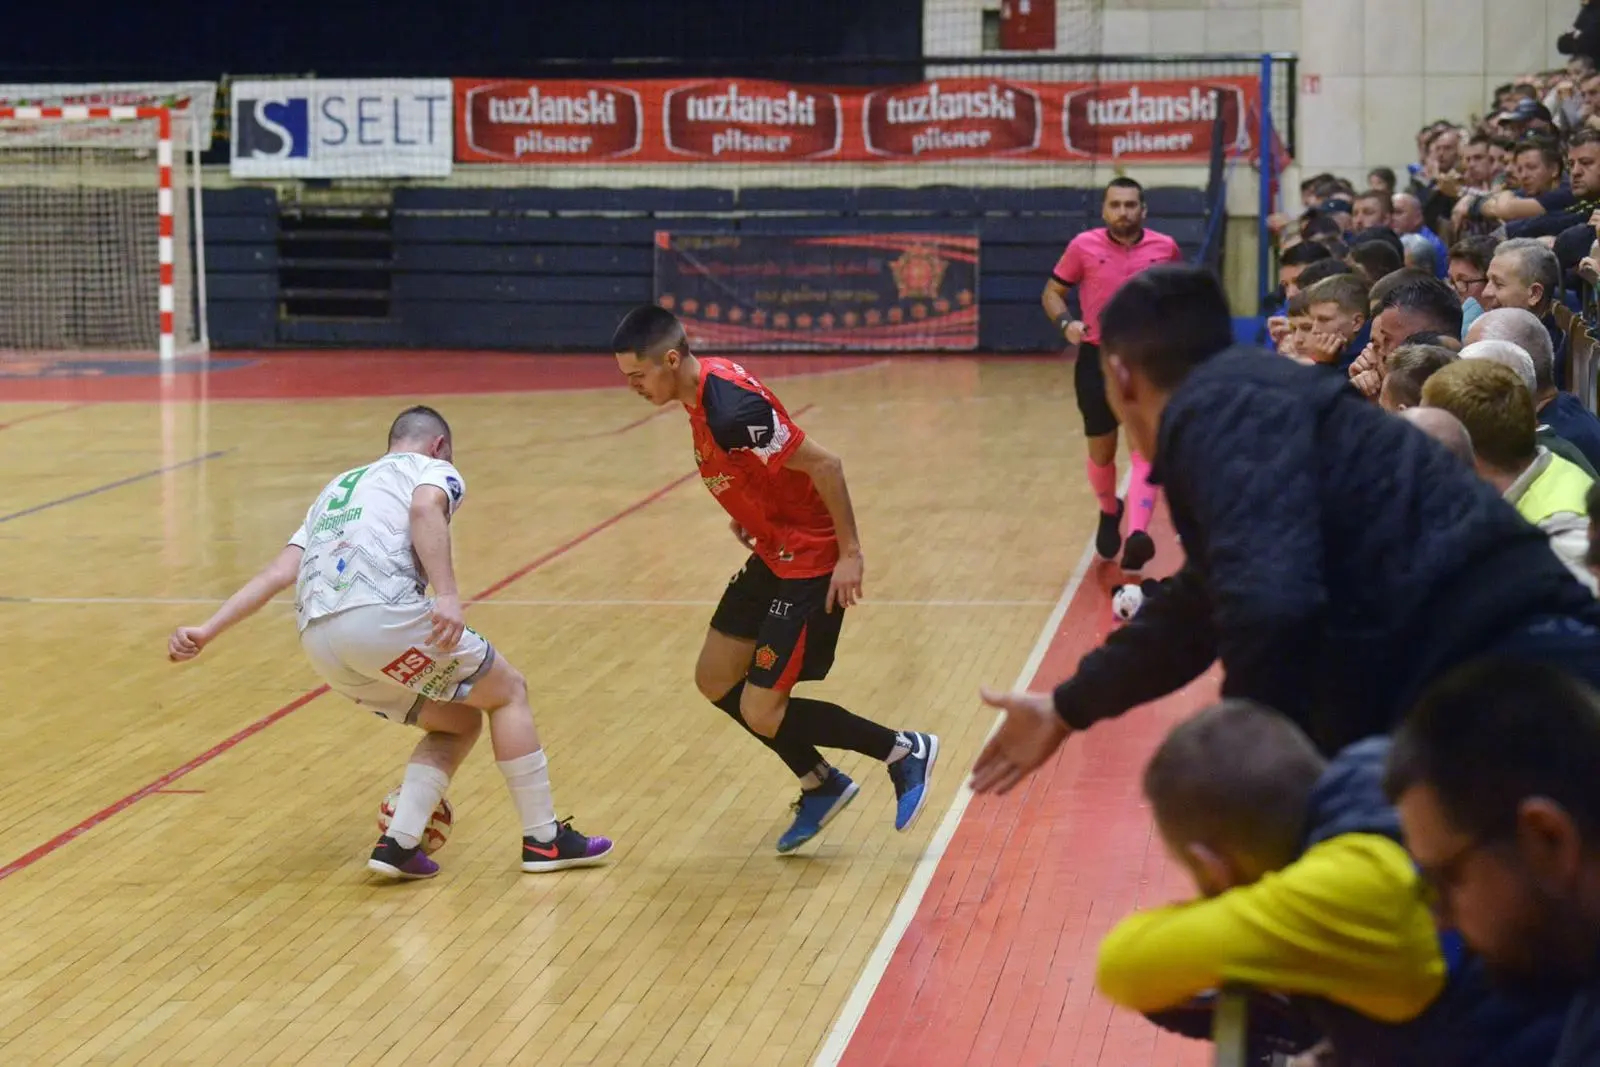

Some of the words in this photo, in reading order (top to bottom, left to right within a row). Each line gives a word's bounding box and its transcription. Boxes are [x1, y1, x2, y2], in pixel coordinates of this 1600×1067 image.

[321, 95, 446, 146] SELT
[489, 86, 616, 124] tuzlanski
[686, 84, 816, 125] tuzlanski
[886, 83, 1015, 124] tuzlanski
[1087, 86, 1217, 125] tuzlanski
[514, 129, 593, 156] pilsner
[712, 128, 791, 155] pilsner
[912, 129, 991, 154] pilsner
[1112, 131, 1193, 156] pilsner
[327, 467, 369, 510] 9
[387, 653, 426, 682] HS
